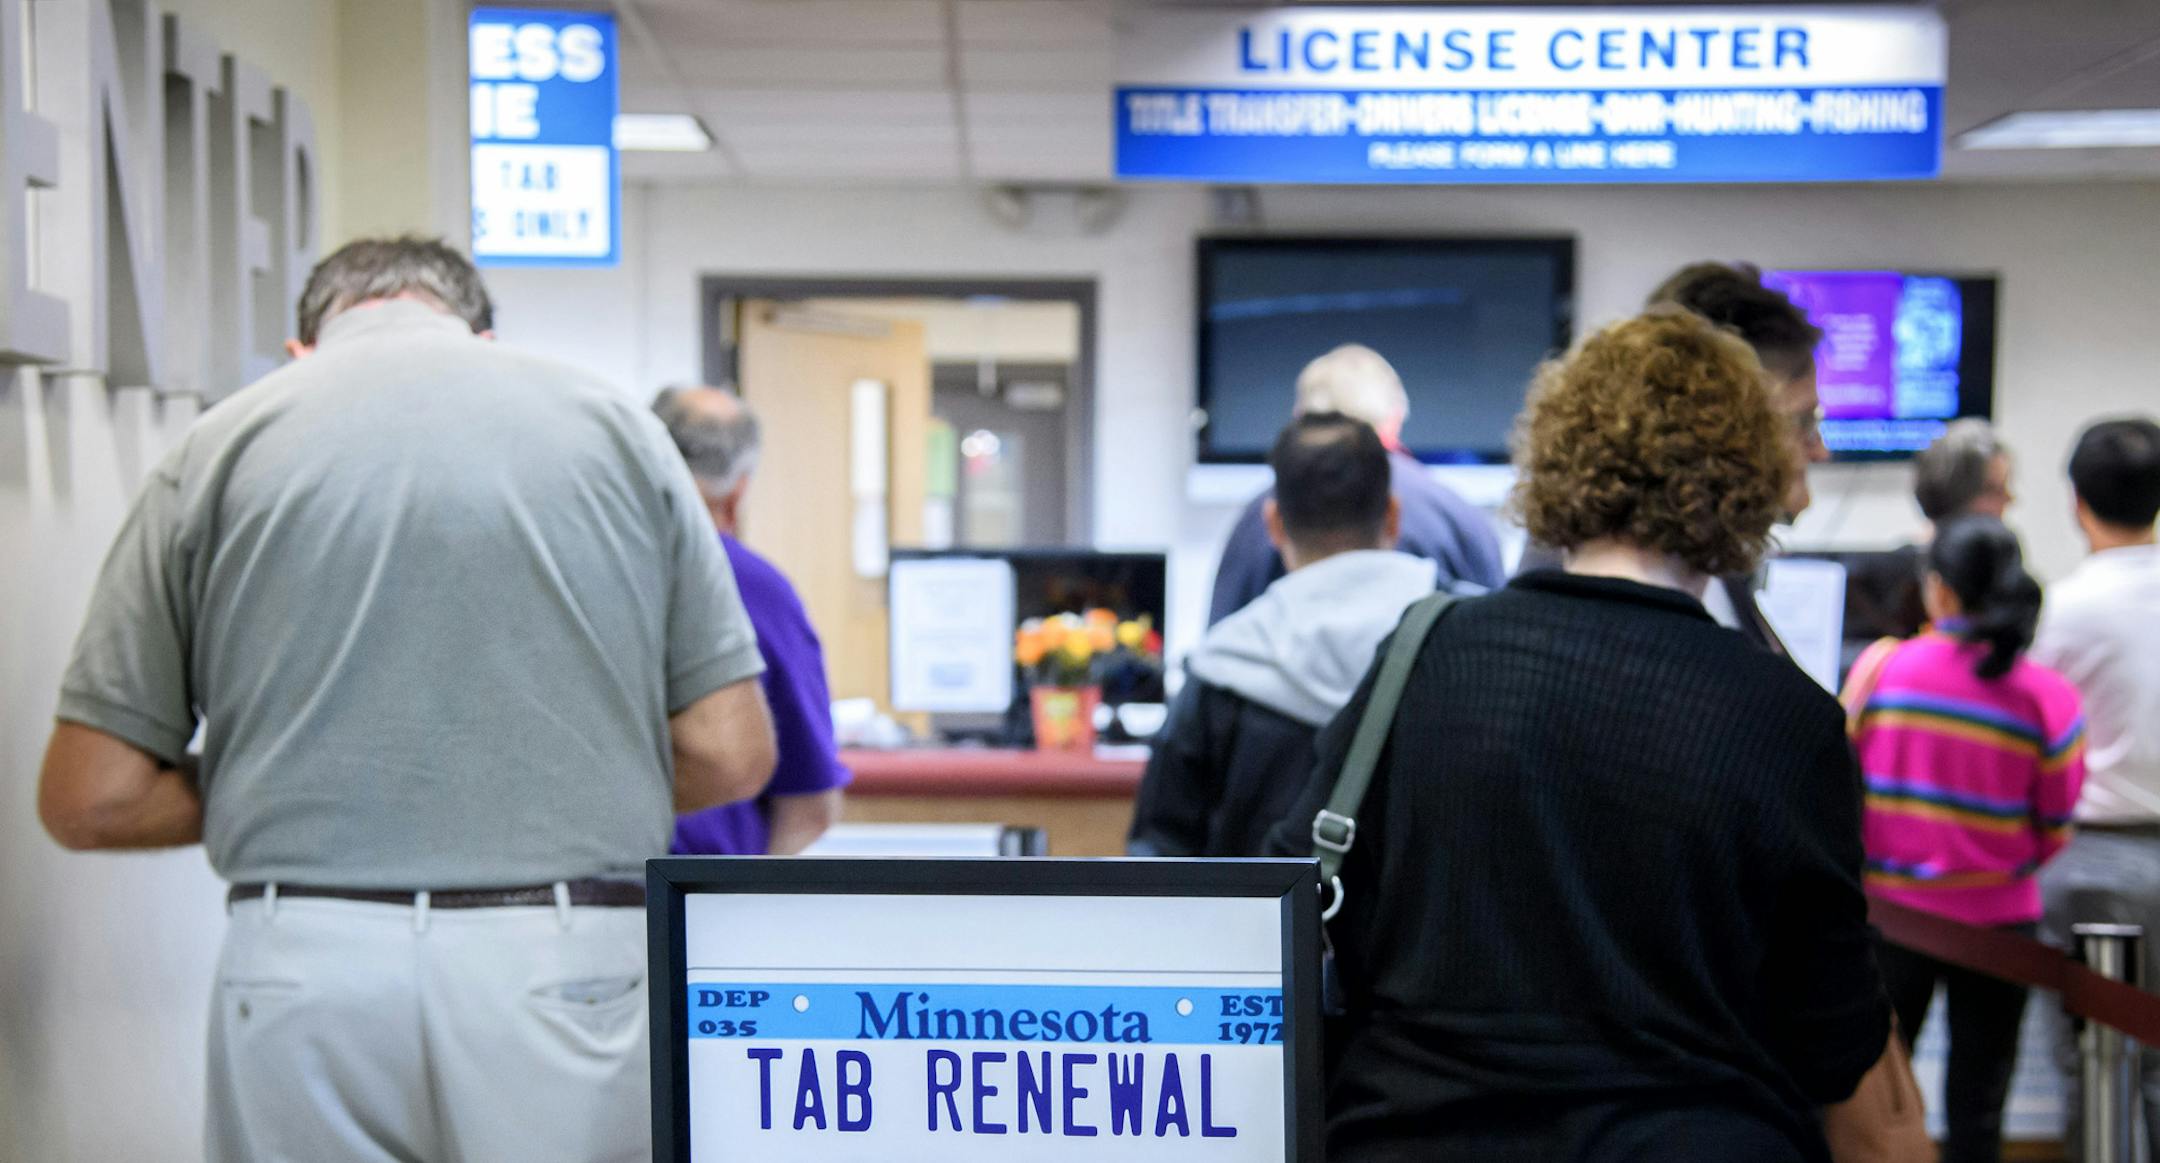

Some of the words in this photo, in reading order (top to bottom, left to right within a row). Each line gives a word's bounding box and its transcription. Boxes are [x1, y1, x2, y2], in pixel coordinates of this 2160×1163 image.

[1238, 28, 1516, 71] LICENSE
[1548, 27, 1811, 70] CENTER
[698, 990, 770, 1008] DEP
[855, 991, 1152, 1043] Minnesota
[698, 1019, 758, 1037] 035
[747, 1048, 872, 1132] TAB
[927, 1049, 1237, 1138] RENEWAL
